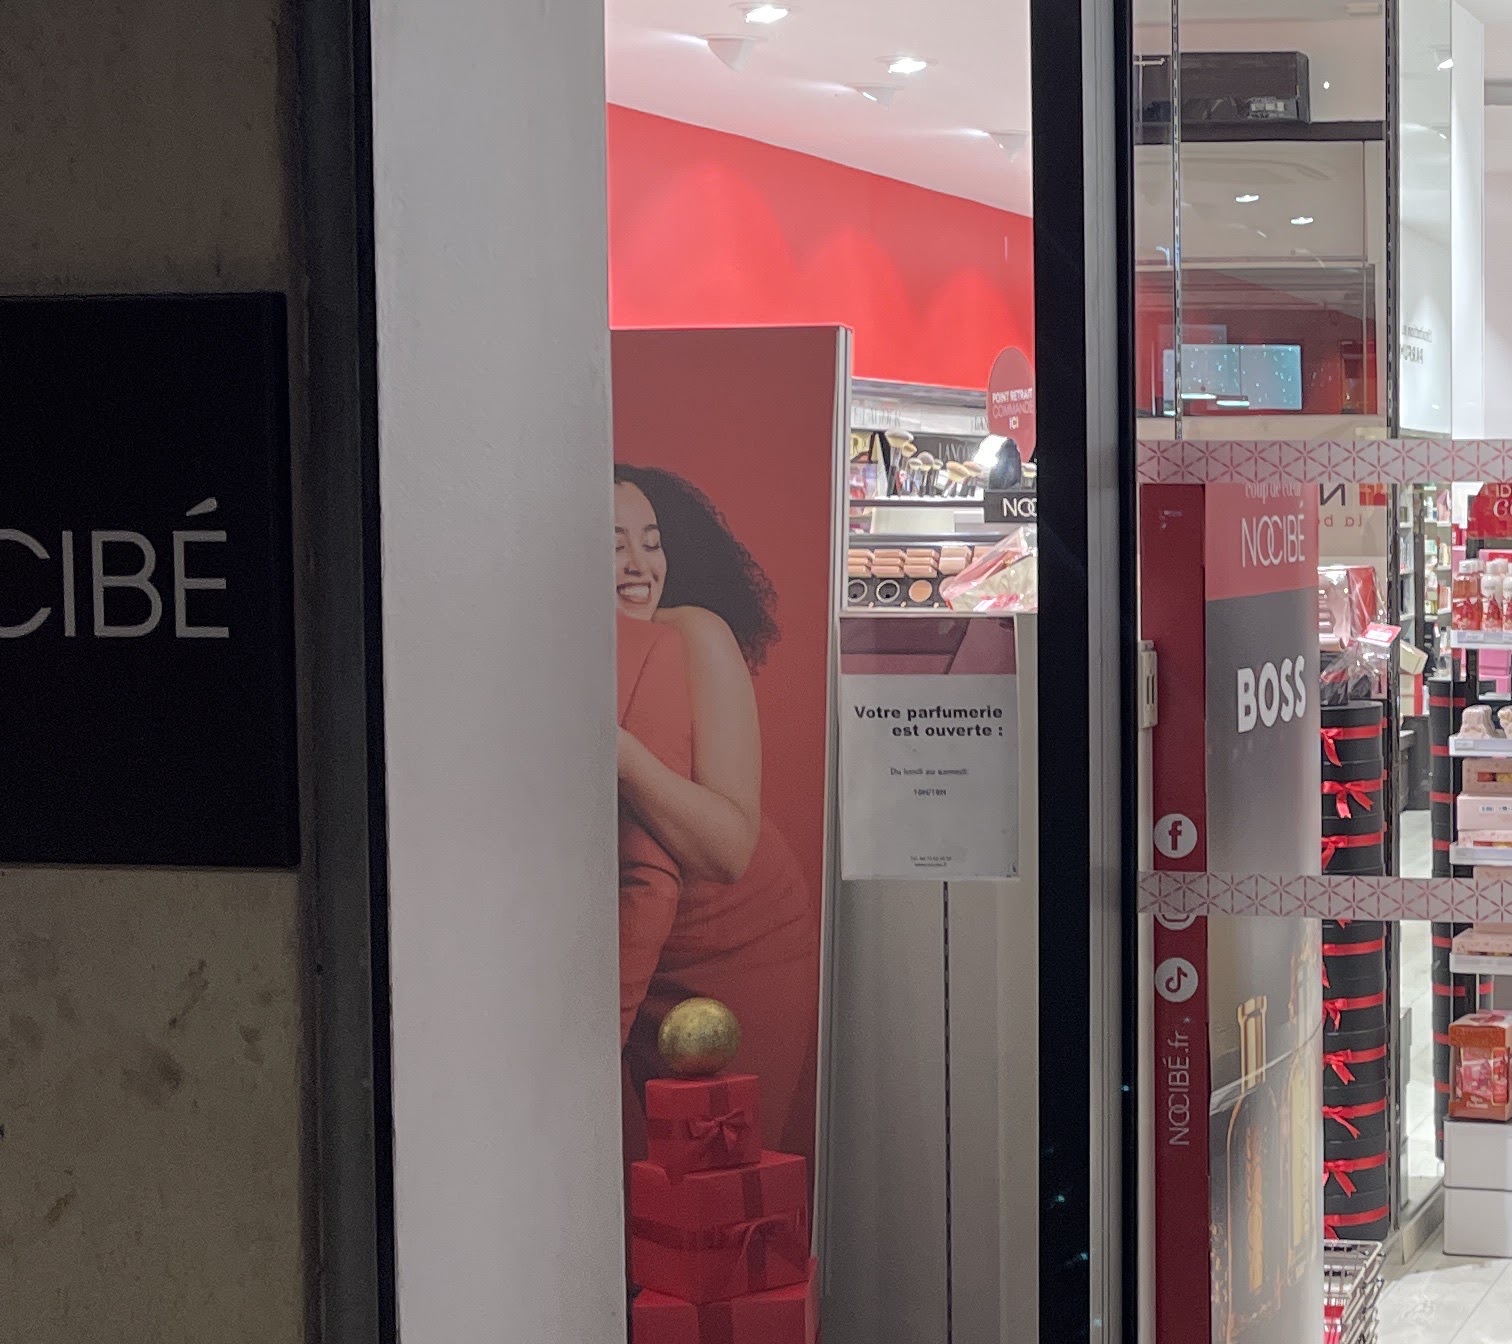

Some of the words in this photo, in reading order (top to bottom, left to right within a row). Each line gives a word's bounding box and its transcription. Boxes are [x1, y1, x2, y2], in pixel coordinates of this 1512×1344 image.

[992, 390, 1009, 403] POINT
[1241, 500, 1306, 568] NOCIBÉ
[854, 705, 901, 718] Votre
[907, 705, 1003, 721] parfumerie
[1237, 655, 1306, 733] BOSS
[892, 725, 919, 736] est
[925, 725, 992, 736] ouverte
[1162, 1030, 1190, 1146] NOCIBÉ.fr
